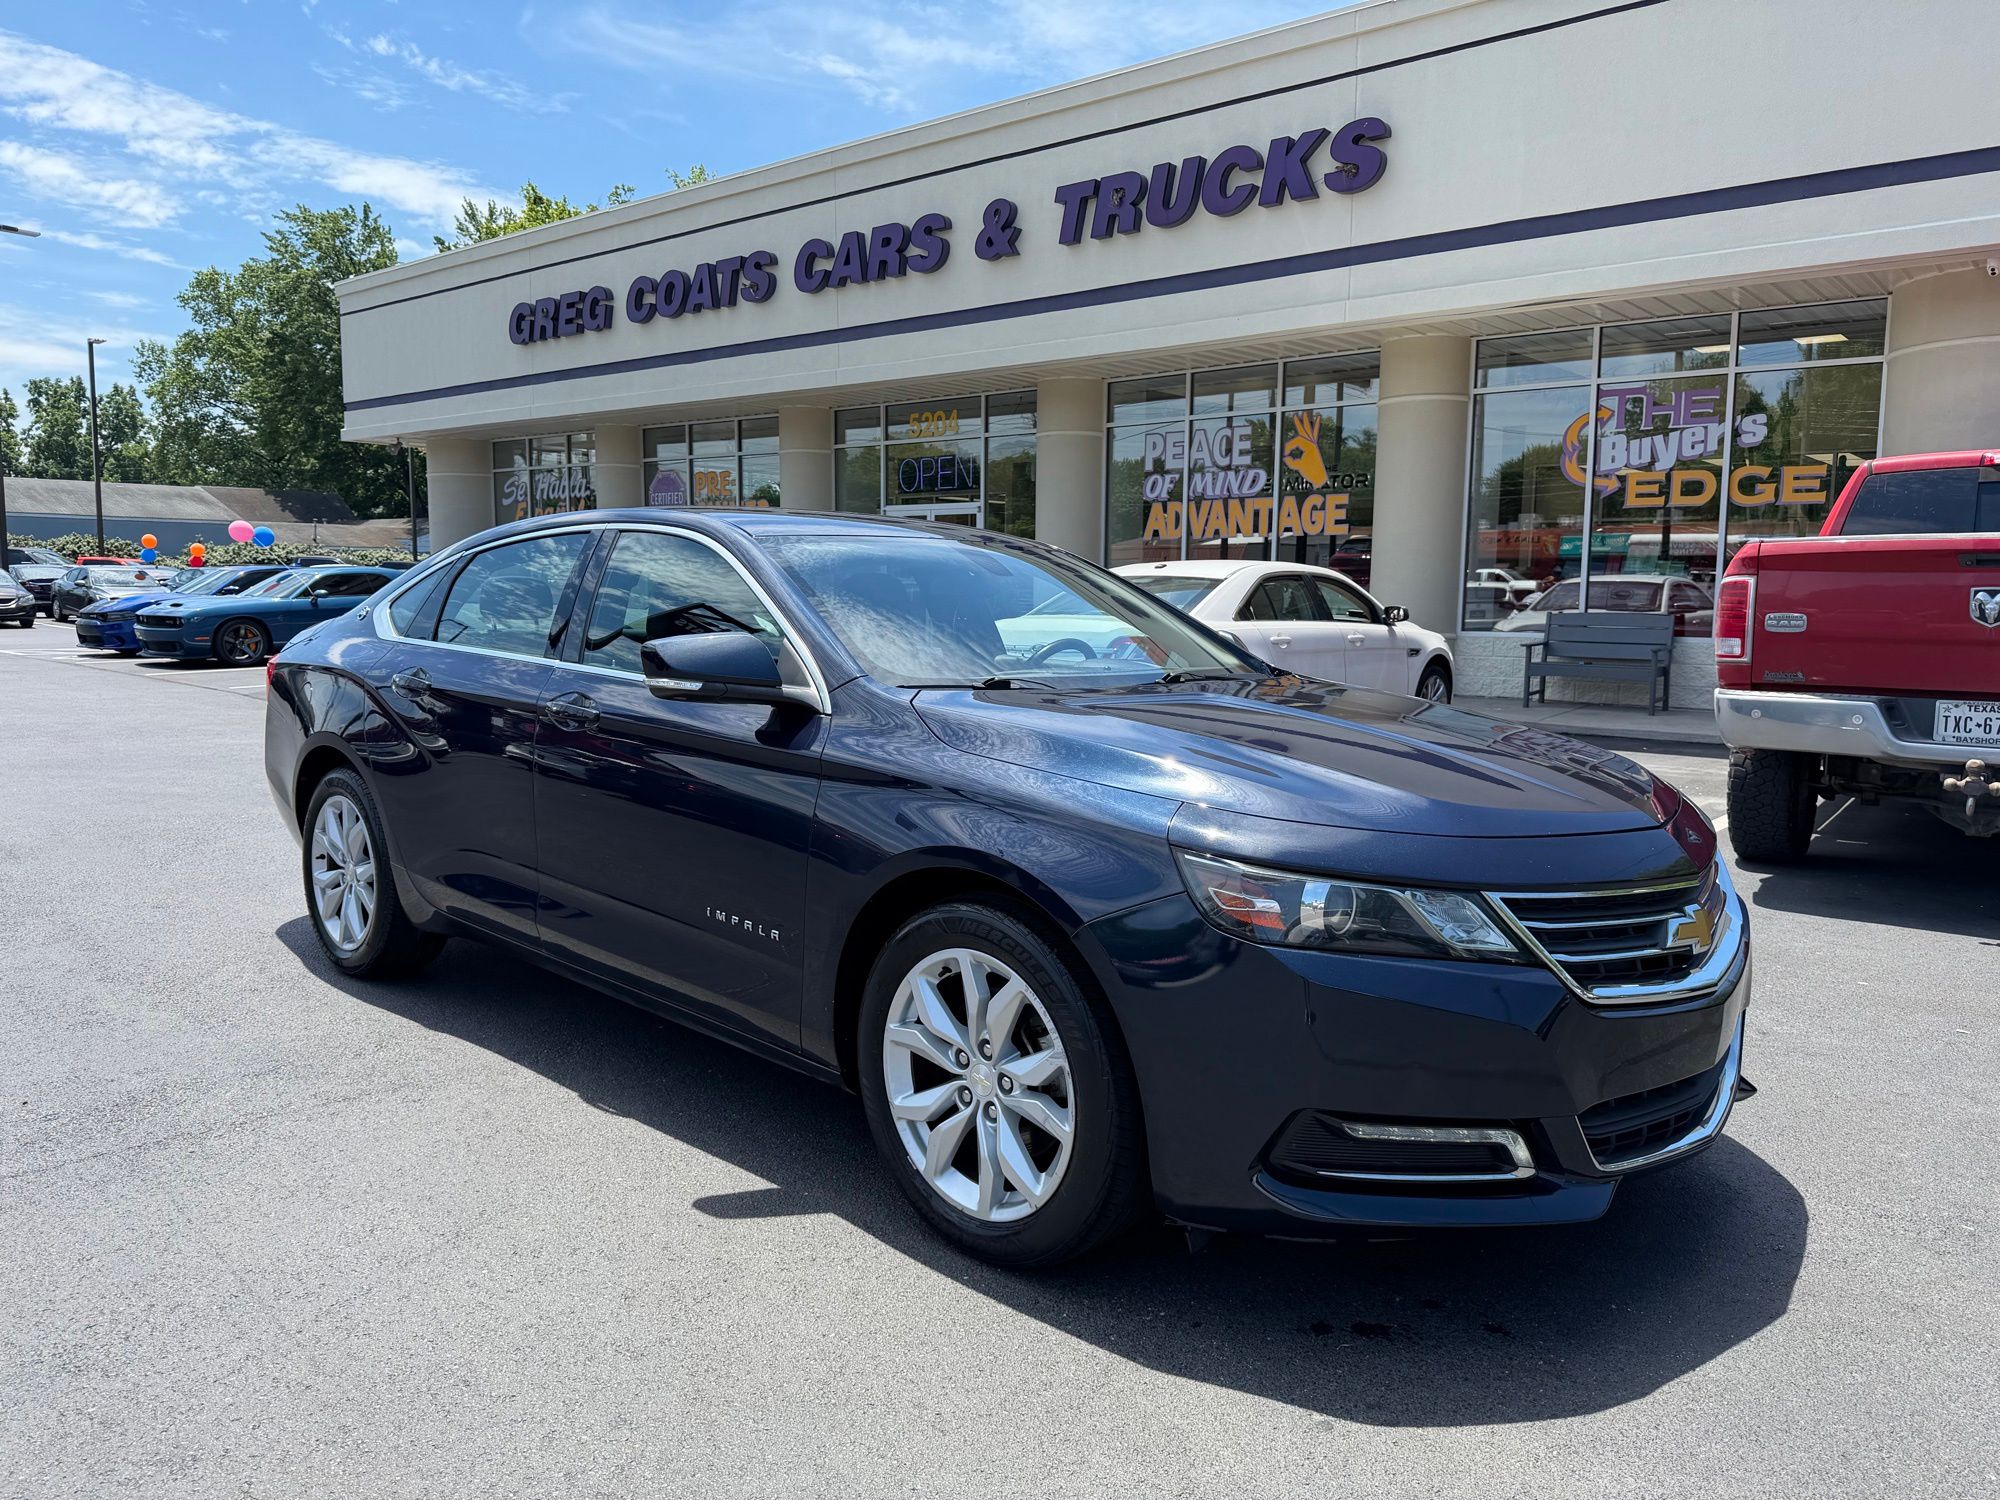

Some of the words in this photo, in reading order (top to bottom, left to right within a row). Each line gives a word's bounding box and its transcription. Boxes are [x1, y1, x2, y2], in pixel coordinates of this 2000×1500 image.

[509, 285, 614, 345] GREG
[626, 250, 778, 324] COATS
[794, 213, 953, 293] CARS
[975, 198, 1022, 261] &
[1055, 117, 1392, 246] TRUCKS
[909, 408, 959, 438] 5204
[1600, 383, 1720, 431] THE
[1144, 425, 1253, 473] PEACE
[1598, 413, 1768, 472] Buyer's
[502, 476, 526, 506] Se
[535, 466, 591, 500] Habla
[694, 470, 737, 497] PRE-
[899, 453, 974, 492] OPEN
[1144, 473, 1180, 500] OF
[1189, 467, 1268, 500] MIND
[1622, 465, 1828, 508] EDGE
[650, 492, 684, 506] CERTIFIED
[1143, 493, 1350, 542] ADVANTAGE
[706, 907, 780, 941] IMPALA
[961, 917, 1064, 1003] HERCULES
